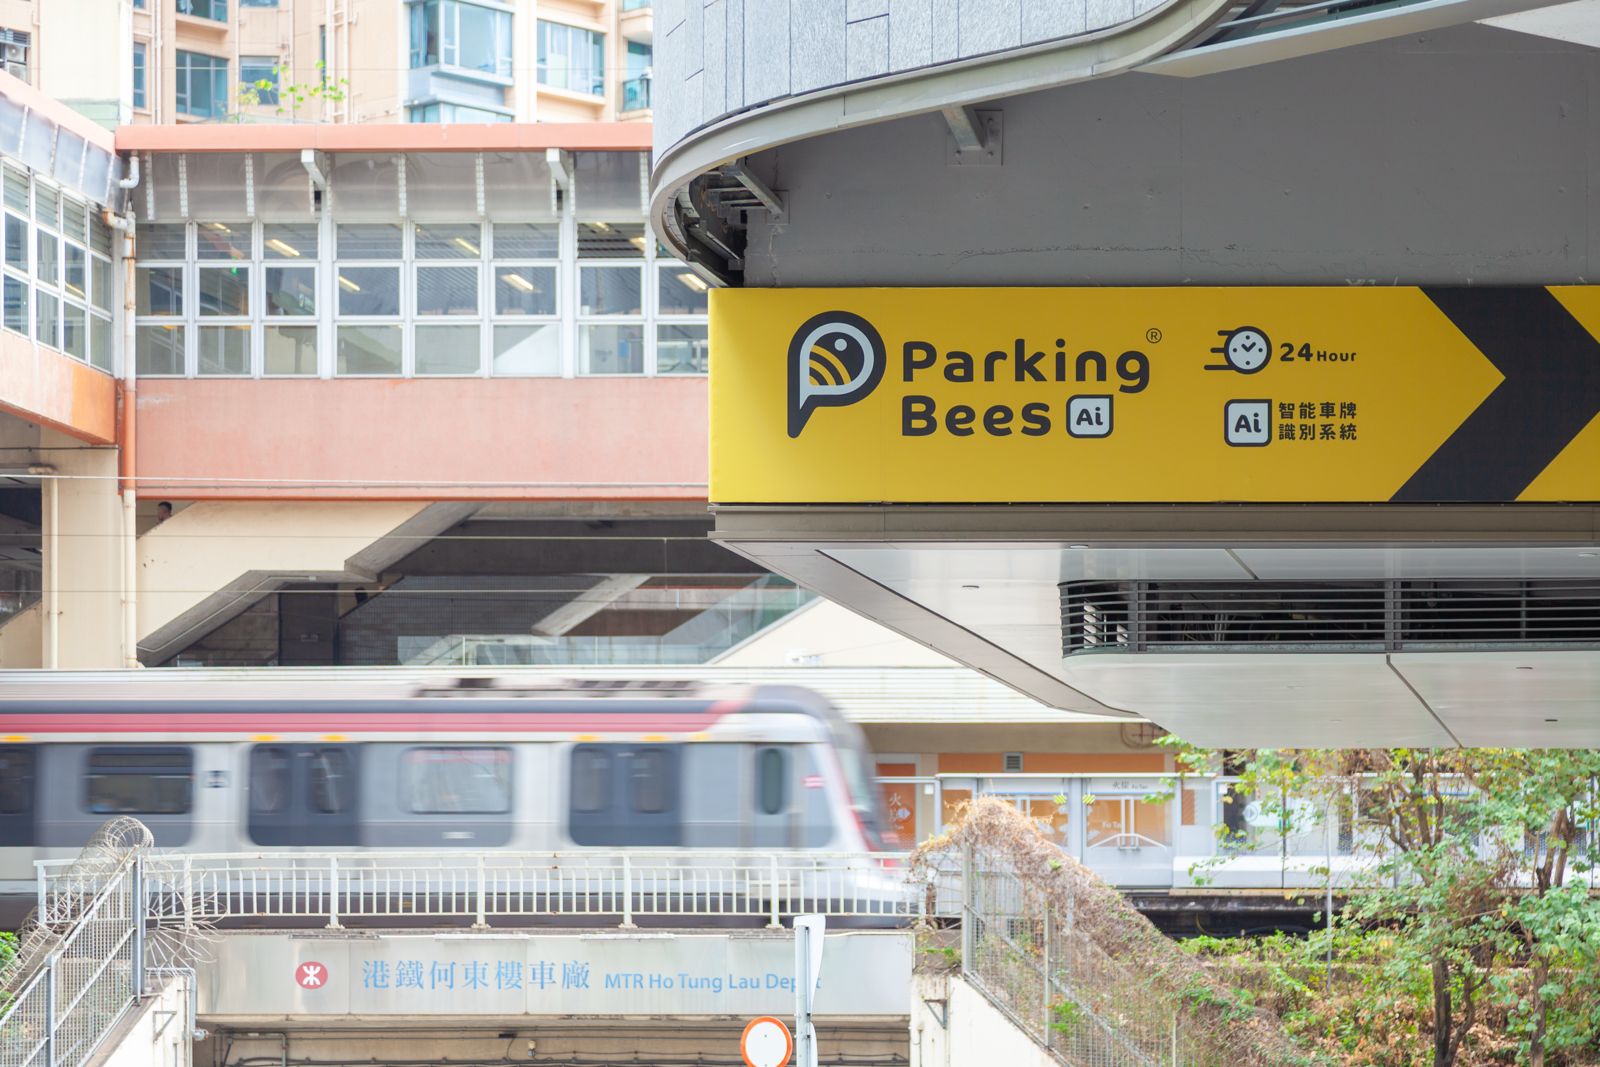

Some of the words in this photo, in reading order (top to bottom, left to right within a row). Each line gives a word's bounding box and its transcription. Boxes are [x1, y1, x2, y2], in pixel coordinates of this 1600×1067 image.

[1280, 343, 1313, 362] 24
[1317, 351, 1357, 362] Hour
[902, 338, 1150, 393] Parking
[902, 395, 1052, 437] Bees
[1075, 406, 1104, 426] Ai
[1278, 402, 1357, 420] 智能車牌
[1234, 412, 1262, 433] Ai
[1278, 423, 1357, 441] 識別系統
[361, 960, 590, 990] 港鐵何東樓車廠
[605, 974, 644, 989] MTR
[649, 974, 674, 989] Ho
[678, 974, 722, 993] Tung
[729, 974, 760, 989] Lau
